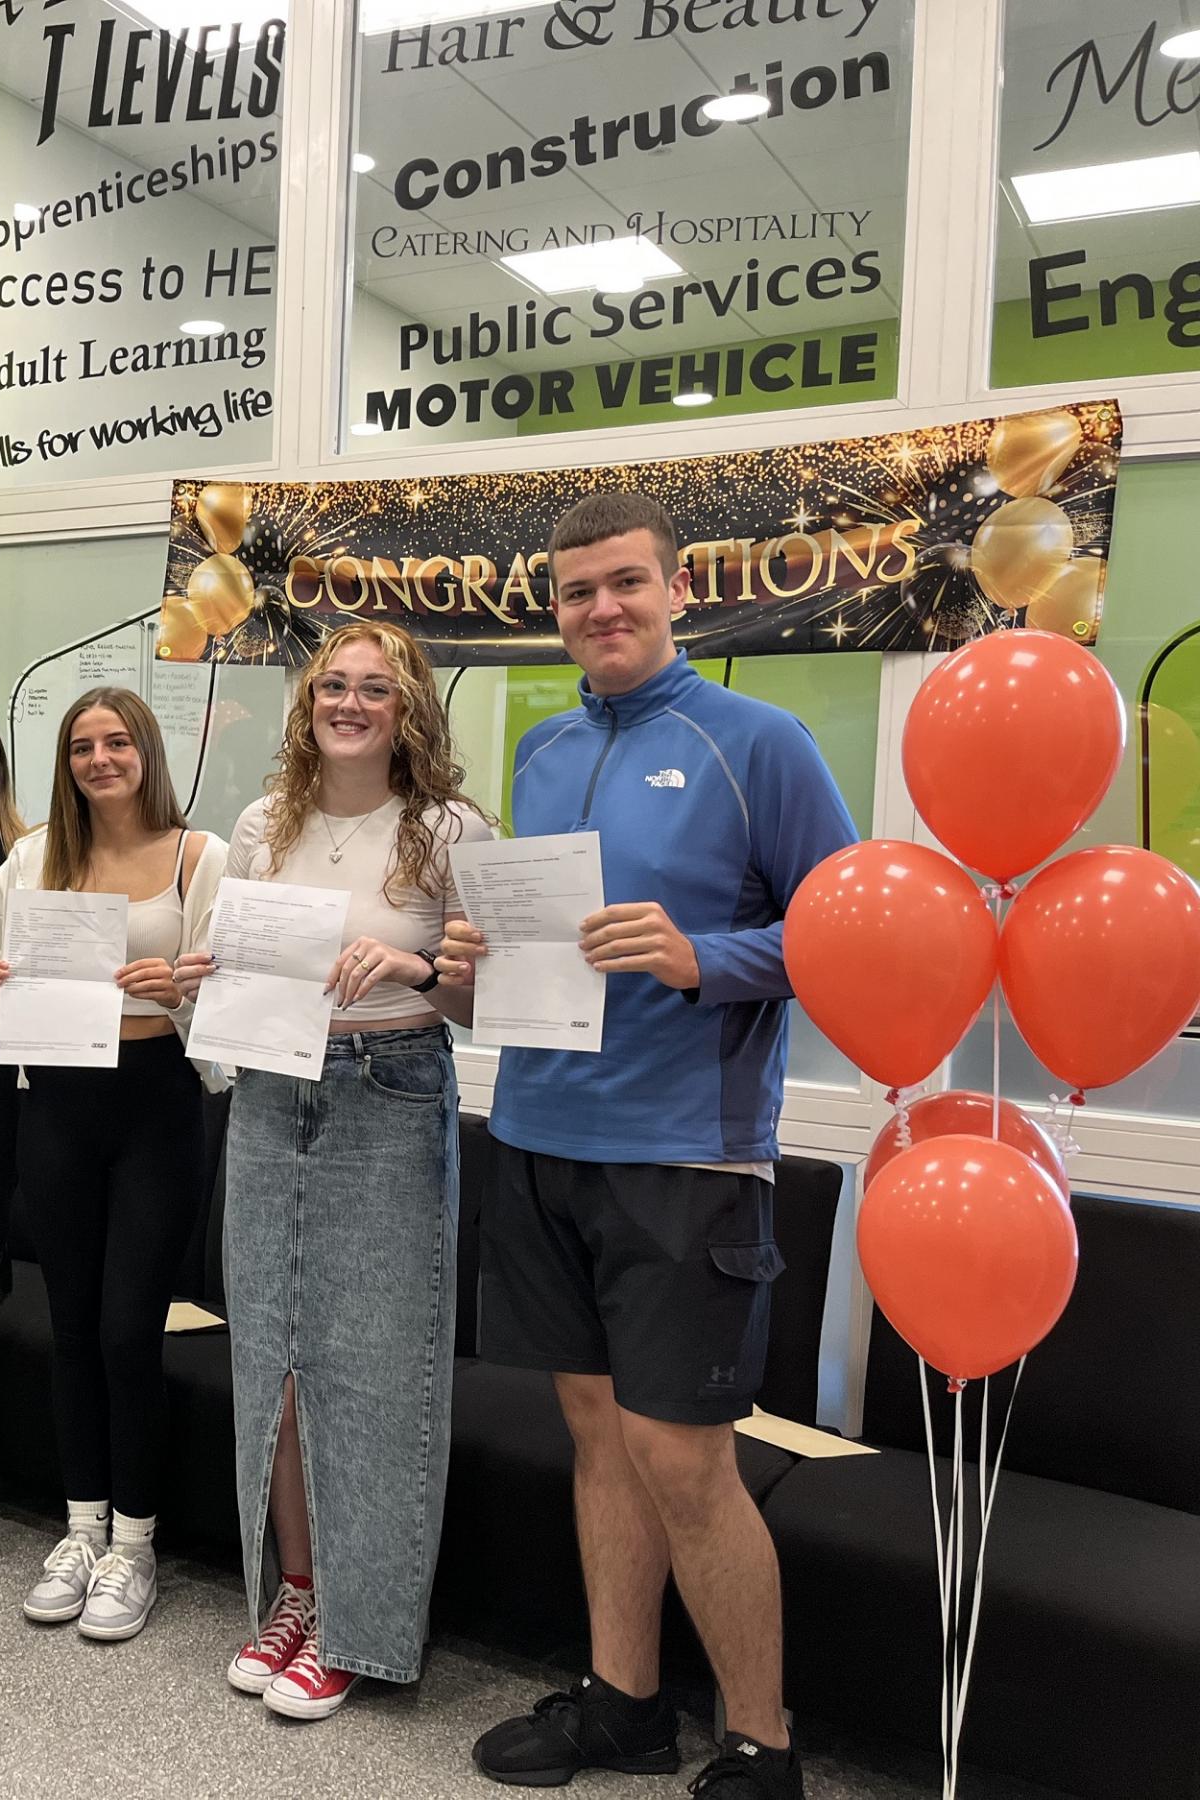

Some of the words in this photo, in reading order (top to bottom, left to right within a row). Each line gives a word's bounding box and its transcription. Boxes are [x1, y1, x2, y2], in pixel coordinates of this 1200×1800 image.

[381, 16, 525, 74] Hair
[543, 0, 615, 51] &
[634, 0, 883, 41] Beauty
[36, 23, 75, 146] T
[88, 18, 286, 127] LEVELS
[394, 51, 890, 211] Construction
[142, 257, 184, 300] to
[205, 245, 277, 298] HE
[371, 225, 530, 259] CATERING
[626, 210, 873, 246] HOSPITALITY
[78, 327, 267, 379] Learning
[400, 300, 572, 371] Public
[590, 250, 882, 338] Services
[37, 429, 85, 460] for
[89, 402, 223, 450] working
[223, 387, 273, 423] life
[366, 370, 575, 432] MOTOR
[595, 332, 879, 409] VEHICLE
[285, 518, 921, 624] CONGRATIONS
